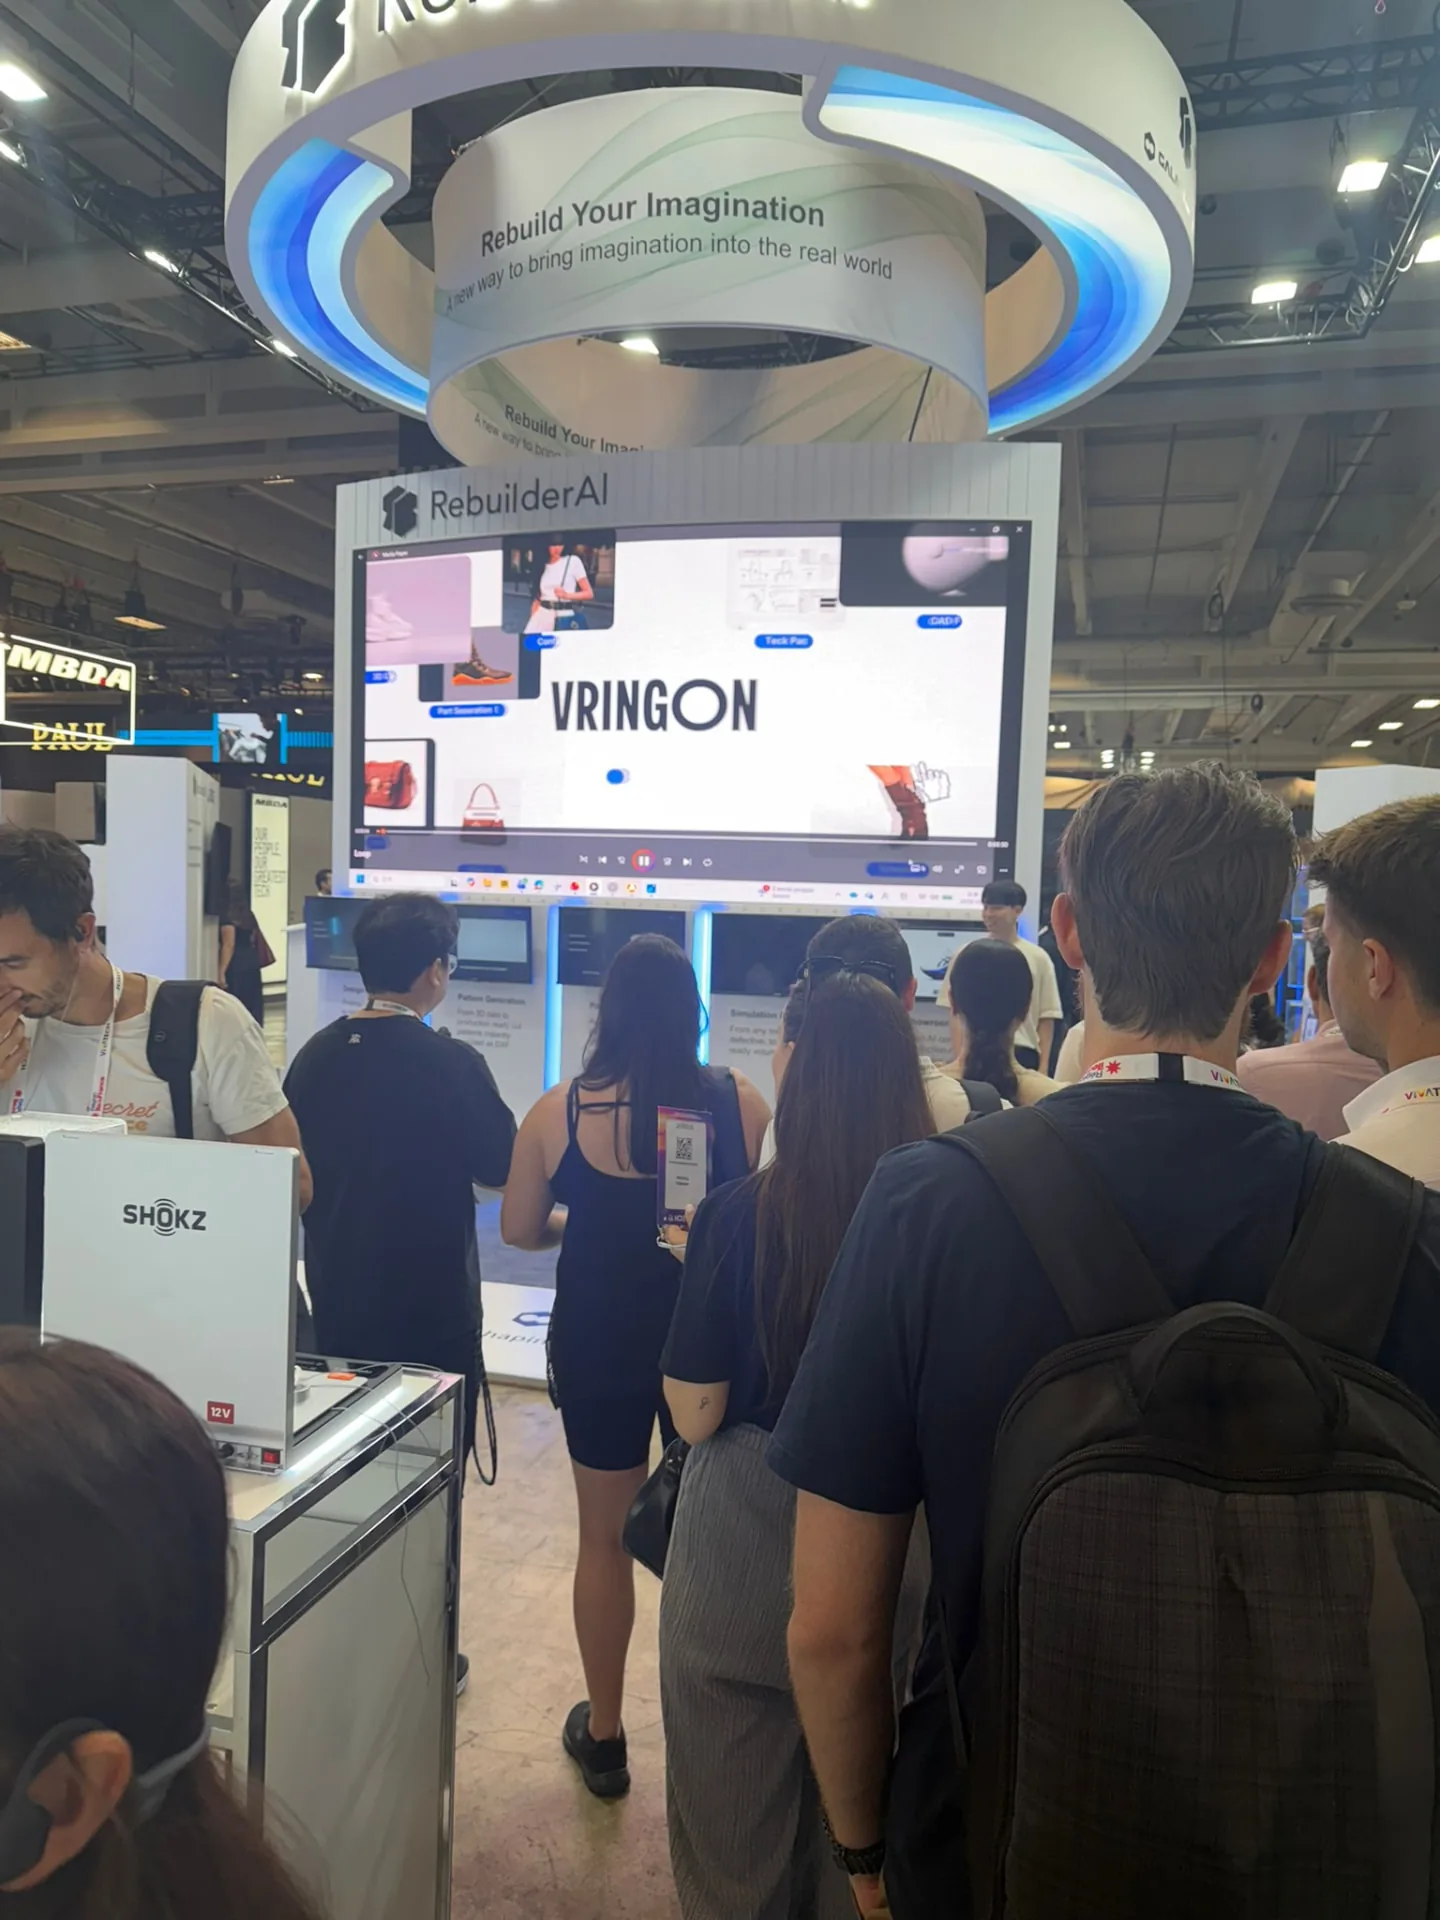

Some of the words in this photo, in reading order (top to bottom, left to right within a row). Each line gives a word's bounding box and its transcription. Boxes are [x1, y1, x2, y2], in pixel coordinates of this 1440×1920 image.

[481, 206, 563, 257] Rebuild
[571, 201, 637, 227] Your
[647, 192, 825, 227] Imagination
[453, 282, 476, 305] new
[477, 270, 505, 290] way
[509, 262, 523, 280] to
[528, 250, 574, 271] bring
[580, 233, 702, 263] imagination
[711, 233, 751, 255] into
[759, 237, 792, 258] the
[800, 246, 837, 266] real
[843, 252, 893, 280] world
[505, 404, 557, 439] Rebuild
[562, 425, 596, 449] Your
[431, 473, 608, 520] RebuilderAI
[7, 644, 131, 692] MBDA
[552, 678, 758, 732] VRINGON
[30, 722, 113, 751] PAUL
[92, 1101, 160, 1119] ecret
[123, 1203, 207, 1232] SHOKZ
[210, 1406, 231, 1420] 12V
